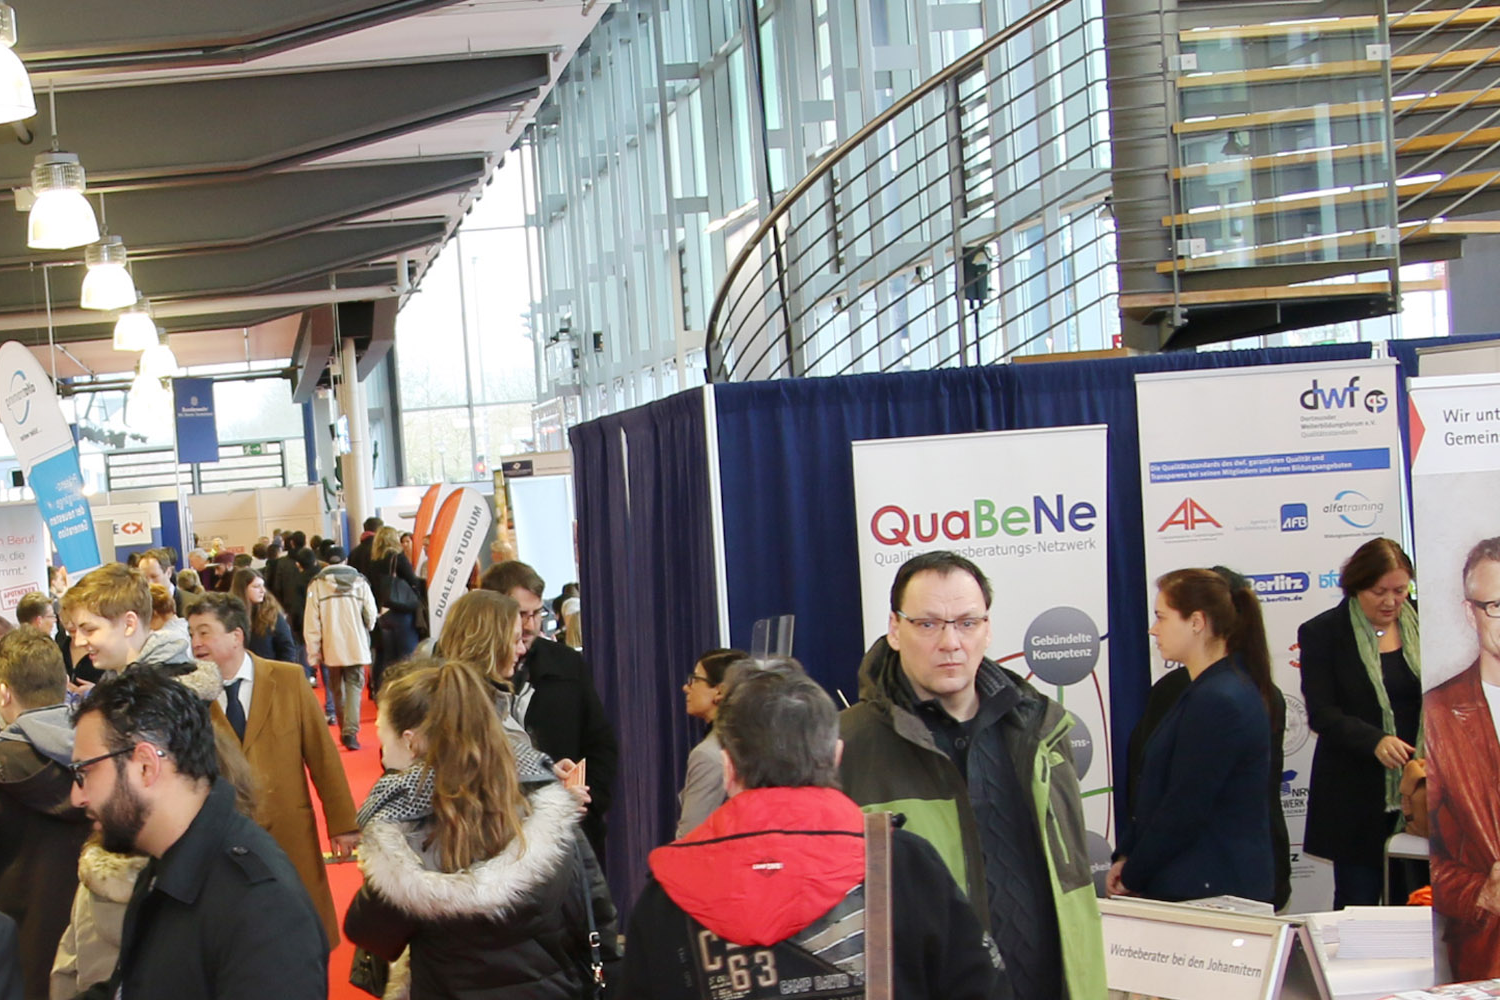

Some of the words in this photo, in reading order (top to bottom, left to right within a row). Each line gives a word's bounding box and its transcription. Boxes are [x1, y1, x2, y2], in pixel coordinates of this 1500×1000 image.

[1299, 376, 1360, 410] dwf
[1443, 408, 1471, 424] Wir
[1151, 472, 1188, 481] Transparenz
[1221, 467, 1258, 476] Mitgliedern
[1272, 465, 1291, 473] deren
[1291, 462, 1353, 472] Bildungsangeboten
[1161, 461, 1220, 472] Qualitätsstandards
[1248, 457, 1285, 467] garantieren
[1285, 455, 1311, 463] Qualität
[1323, 503, 1384, 514] alfatraining
[870, 494, 1097, 547] QuaBeNe
[9, 551, 26, 561] die
[434, 566, 459, 619] DUALES
[454, 504, 483, 566] STUDIUM
[1031, 632, 1093, 647] Gebündelte
[1032, 646, 1093, 661] Kompetenz
[1110, 943, 1169, 964] Werbeberater
[1171, 952, 1186, 966] bei
[1188, 955, 1204, 970] den
[1206, 958, 1262, 978] Johannitern
[727, 950, 778, 991] 63
